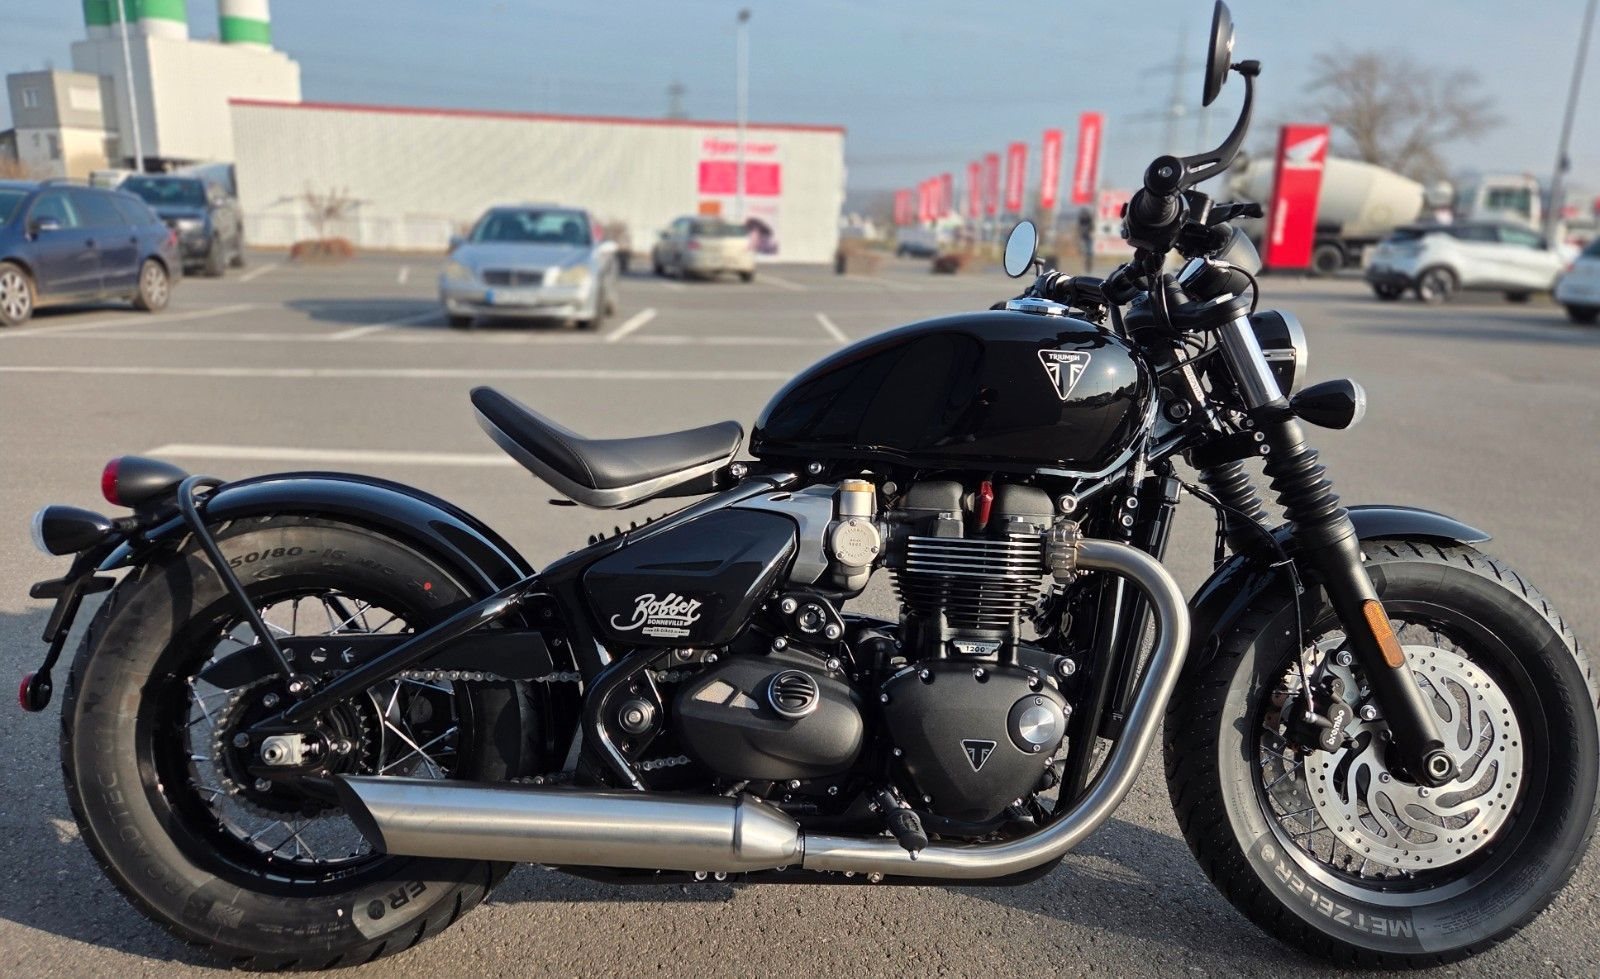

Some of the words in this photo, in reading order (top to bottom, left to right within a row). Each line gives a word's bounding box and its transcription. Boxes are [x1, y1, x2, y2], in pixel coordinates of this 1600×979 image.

[1048, 353, 1080, 362] TRIUMPH
[228, 546, 302, 569] 50/80
[610, 592, 702, 631] Bobber
[647, 618, 684, 627] BONNEVILLE
[1326, 710, 1345, 745] brembo
[1273, 858, 1414, 938] METZELER
